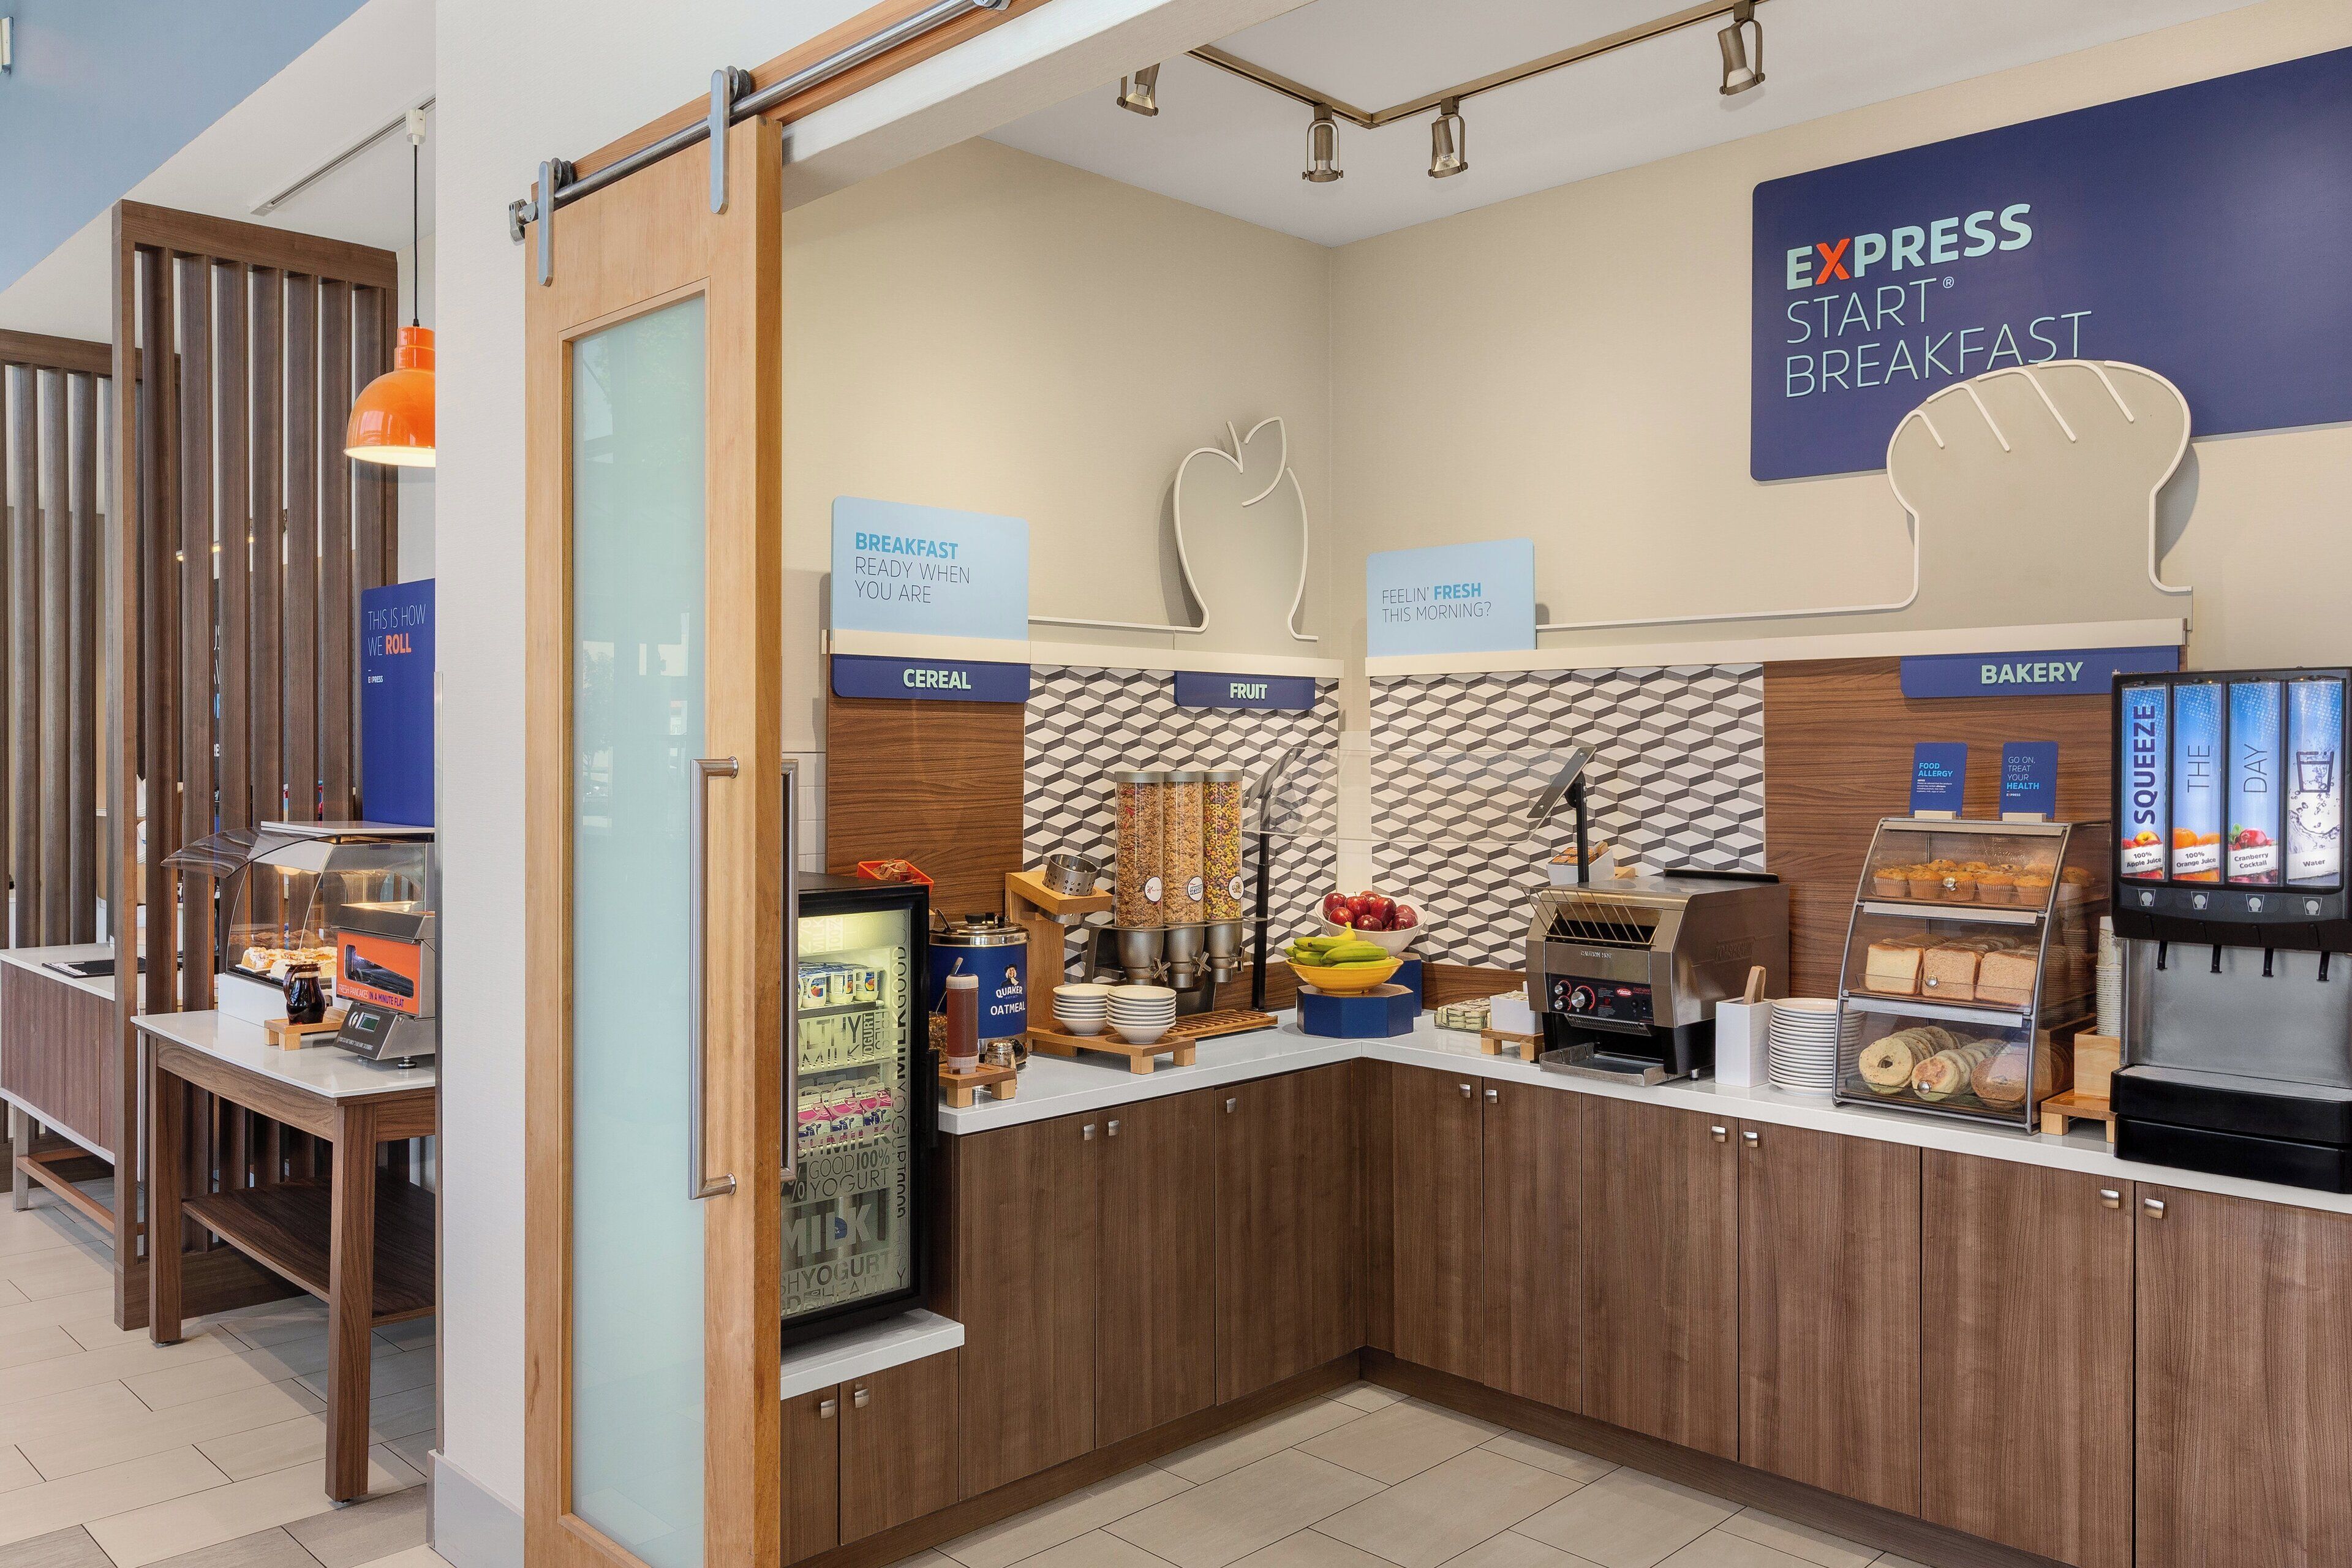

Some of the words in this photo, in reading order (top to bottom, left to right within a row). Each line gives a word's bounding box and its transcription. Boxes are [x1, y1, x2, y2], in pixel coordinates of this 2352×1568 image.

[1787, 203, 2033, 290] EXPRESS
[1786, 311, 2092, 399] BREAKFAST
[855, 532, 959, 560] BREAKFAST
[856, 556, 913, 578] READY
[919, 563, 970, 584] WHEN
[854, 579, 891, 600] YOU
[899, 584, 931, 603] ARE
[1382, 586, 1430, 604] FEELIN'
[1433, 582, 1481, 600] FRESH
[368, 609, 388, 630] THIS
[390, 607, 398, 628] IS
[401, 603, 426, 626] HOW
[1382, 606, 1411, 622] THIS
[1416, 601, 1491, 621] MORNING?
[368, 636, 383, 657] WE
[385, 633, 412, 655] ROLL
[903, 669, 971, 690] CEREAL
[1980, 662, 2084, 684] BAKERY
[1229, 682, 1268, 700] FRUIT
[2133, 706, 2158, 824] SQUEEZE
[2187, 745, 2210, 793] THE
[2243, 744, 2267, 793] DAY
[2234, 852, 2269, 862] Cranberry
[2239, 860, 2267, 869] Cocktail
[812, 918, 824, 952] MILK
[339, 984, 350, 994] FRESH
[350, 986, 369, 999] PANCAKES
[374, 992, 378, 1001] A
[378, 993, 394, 1005] MINUTE
[394, 998, 404, 1008] FLAT
[995, 986, 1023, 998] QUAKER
[990, 1001, 1026, 1016] OATMEAL
[862, 1013, 874, 1062] YOGURT
[801, 1044, 861, 1071] MILK
[809, 1154, 854, 1179] GOOD
[857, 1147, 890, 1171] 100%
[810, 1167, 889, 1199] YOGURT
[801, 1252, 889, 1289] YOGURT
